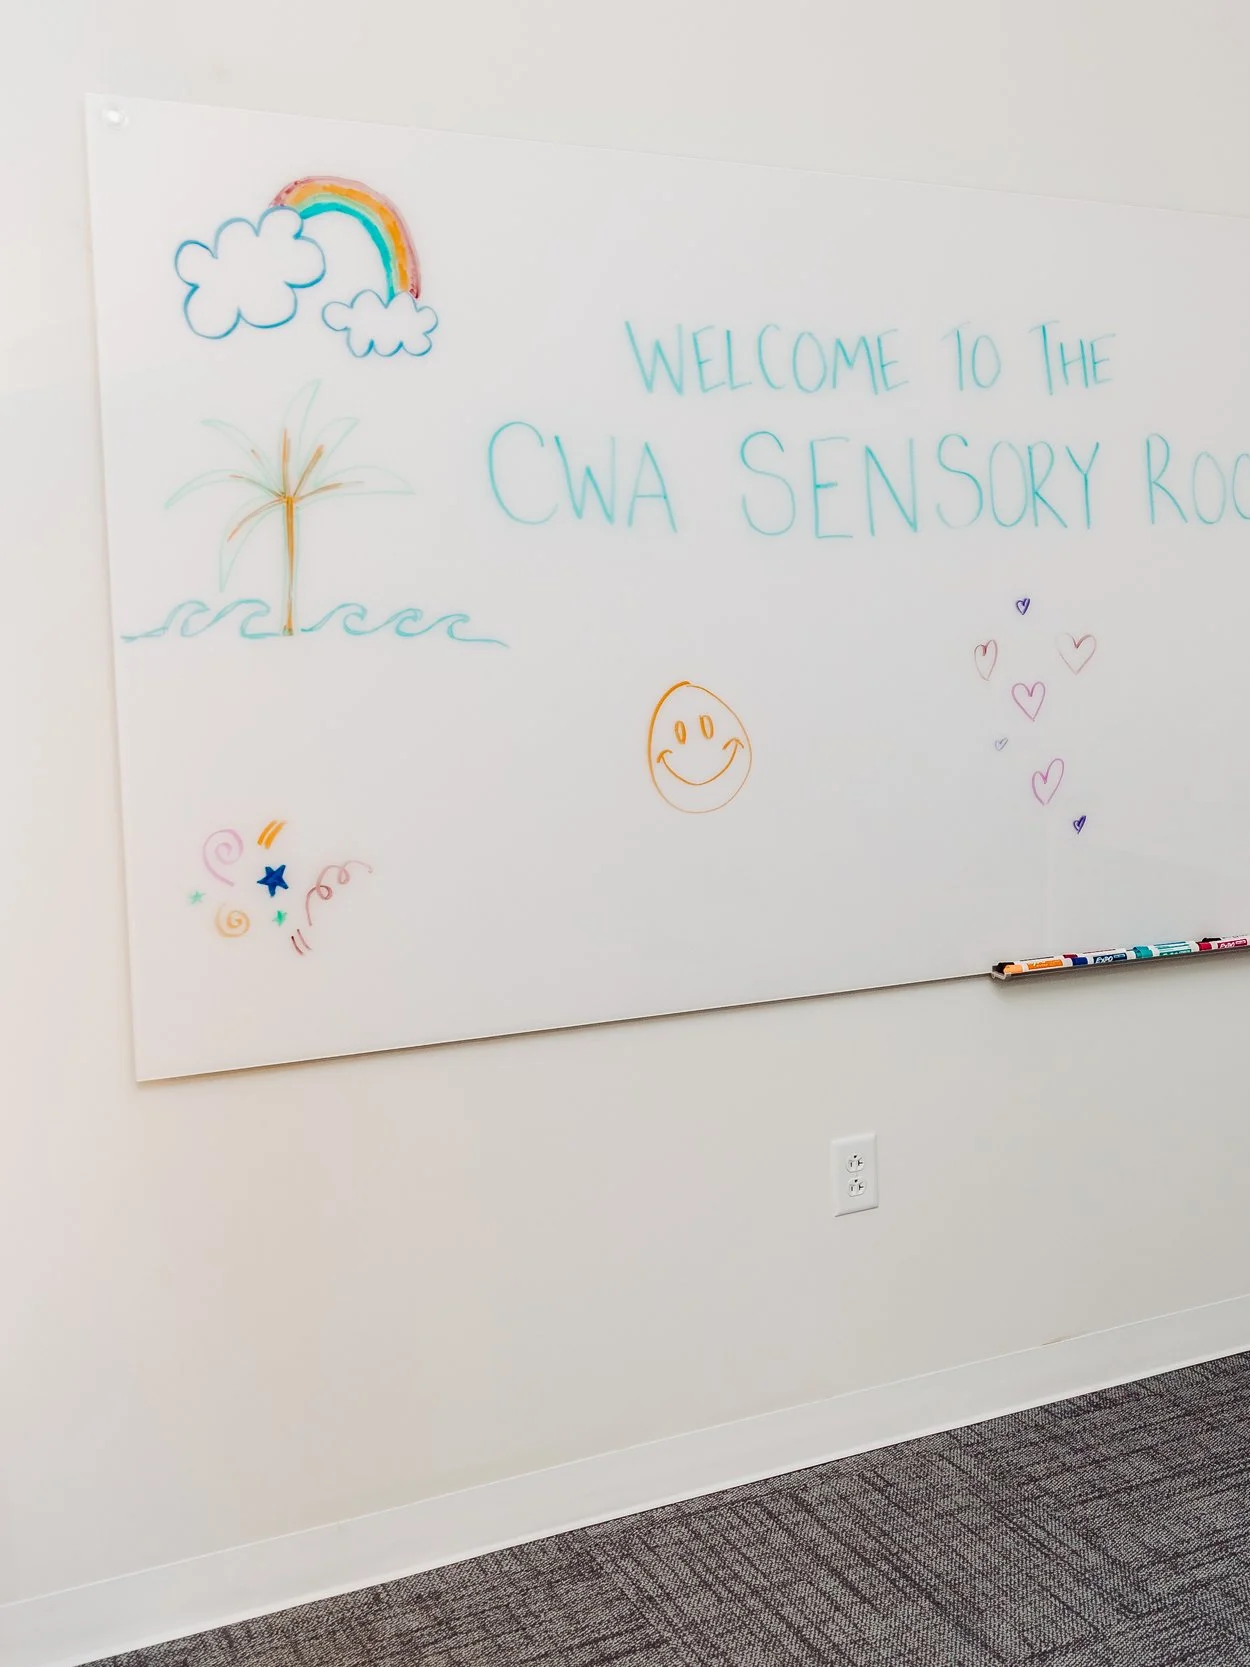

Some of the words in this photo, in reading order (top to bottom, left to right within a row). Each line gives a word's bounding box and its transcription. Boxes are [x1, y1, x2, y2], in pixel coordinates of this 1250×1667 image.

[624, 320, 910, 396] WELCOME
[940, 320, 1001, 392] TO
[1028, 319, 1117, 396] THE
[486, 420, 678, 534] CWA
[738, 429, 1100, 540] SENSORY
